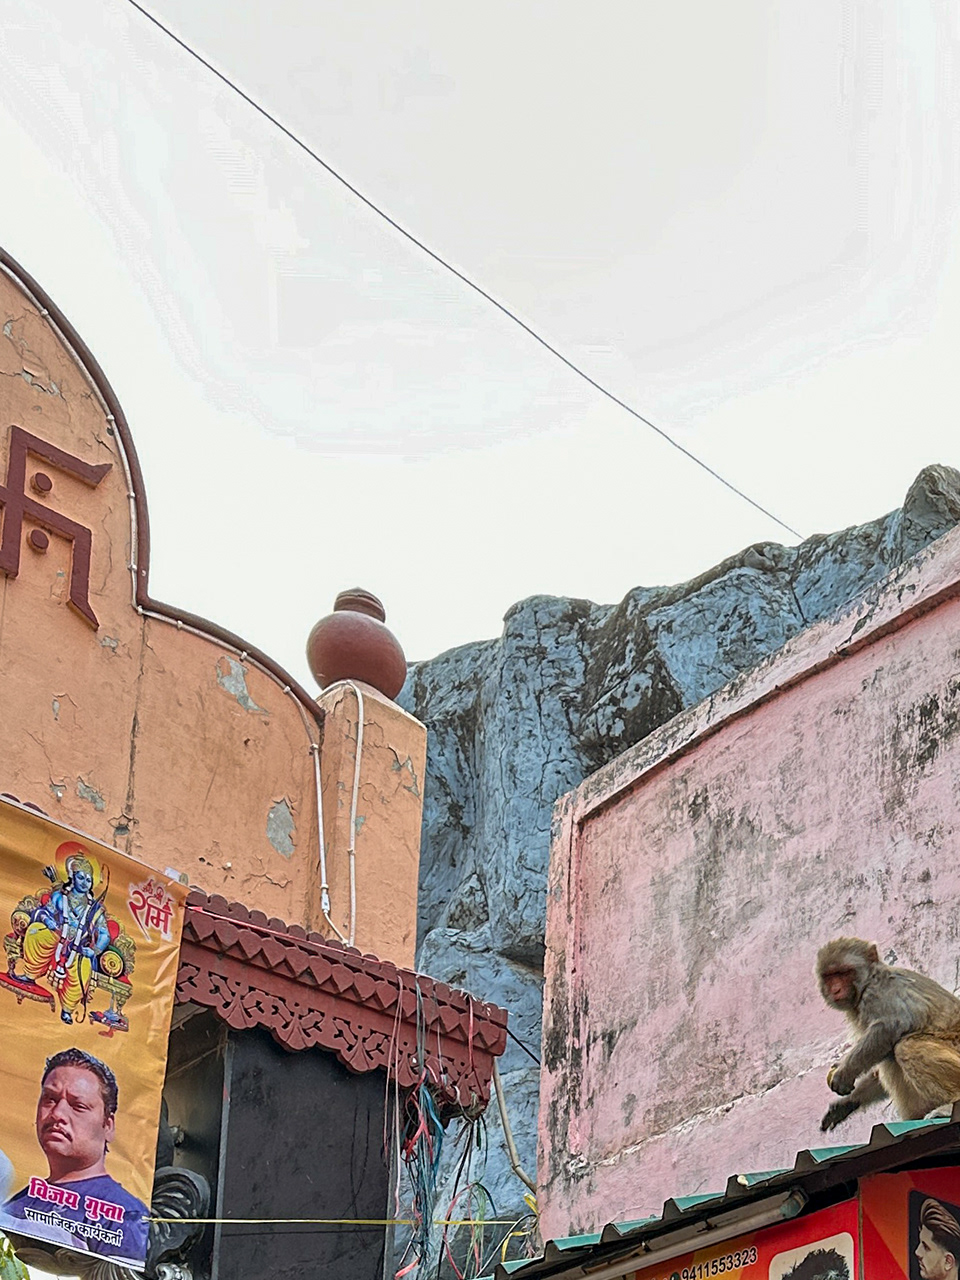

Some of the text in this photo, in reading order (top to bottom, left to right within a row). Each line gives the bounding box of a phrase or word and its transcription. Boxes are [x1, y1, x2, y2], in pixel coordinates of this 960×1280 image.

[29, 1177, 124, 1222] विजय गुप्ता
[25, 1207, 76, 1233] सामाजिक
